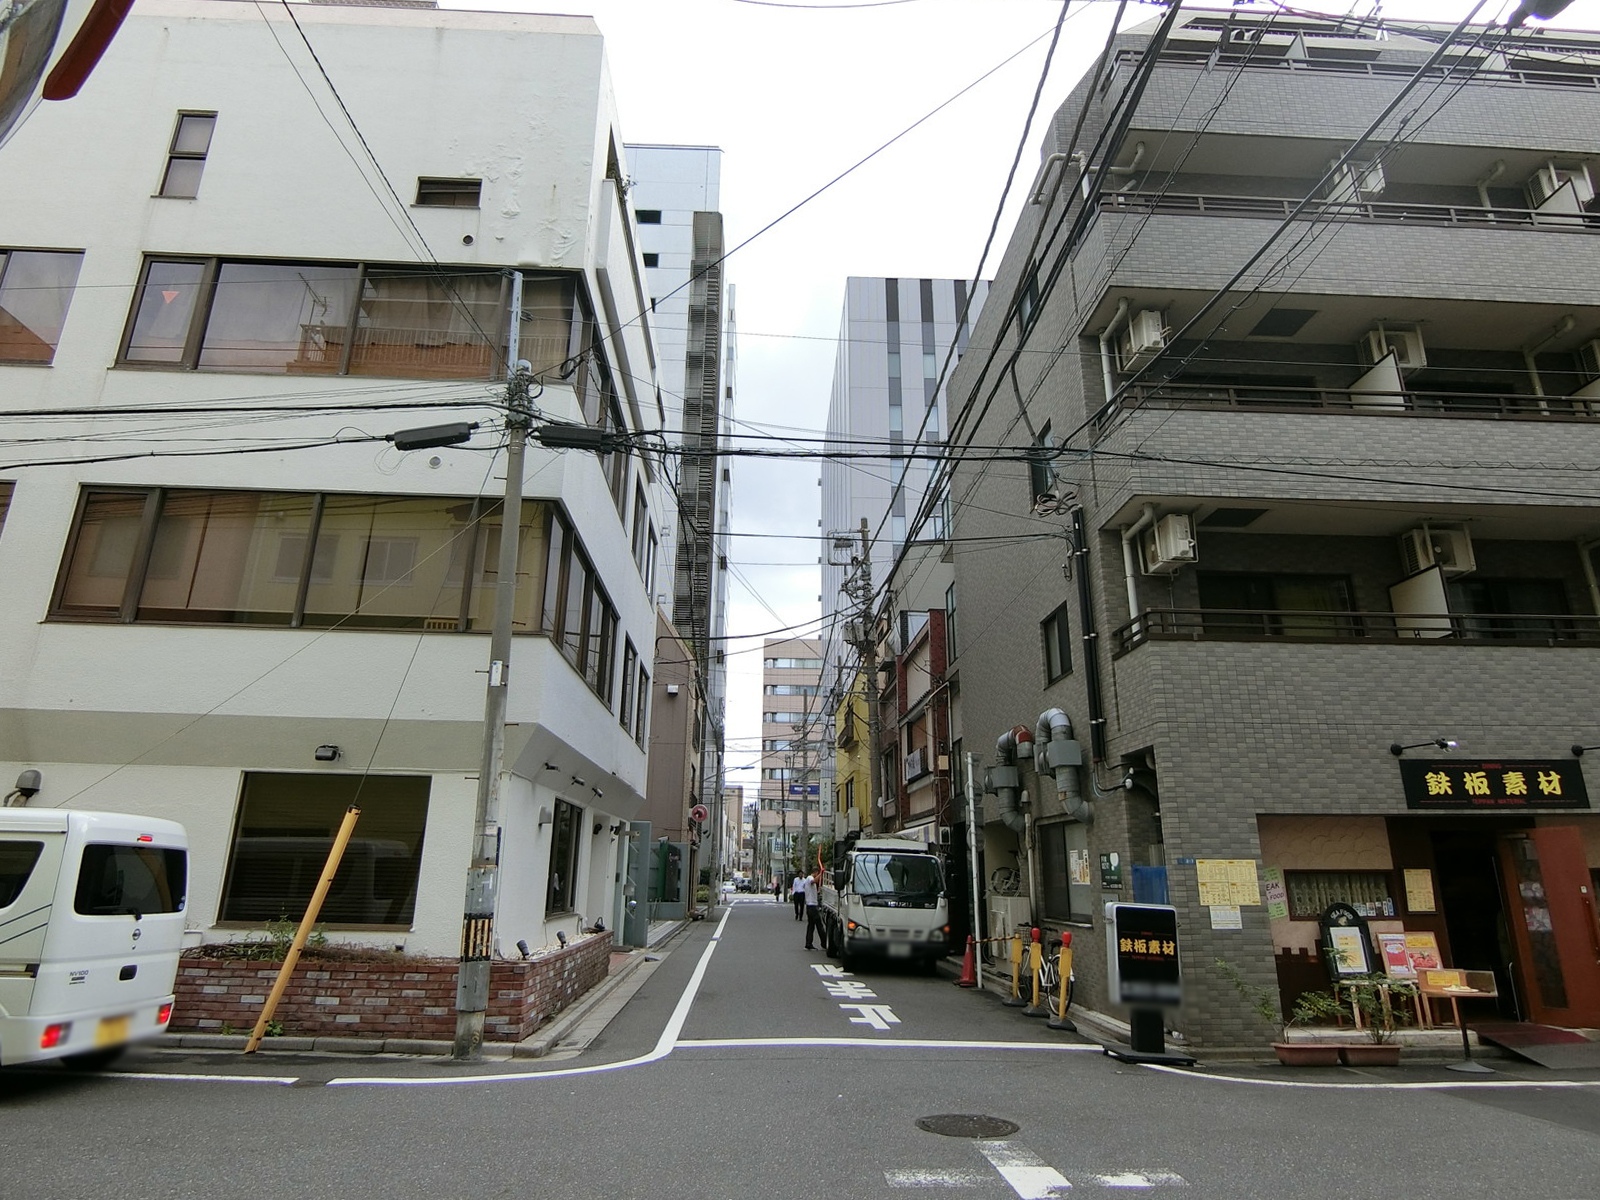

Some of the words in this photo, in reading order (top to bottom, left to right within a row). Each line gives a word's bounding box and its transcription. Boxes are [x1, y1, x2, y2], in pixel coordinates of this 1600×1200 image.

[1424, 770, 1562, 796] 鉄板素材
[1119, 937, 1176, 956] 鉄板素材
[809, 964, 902, 1030] 止まれ
